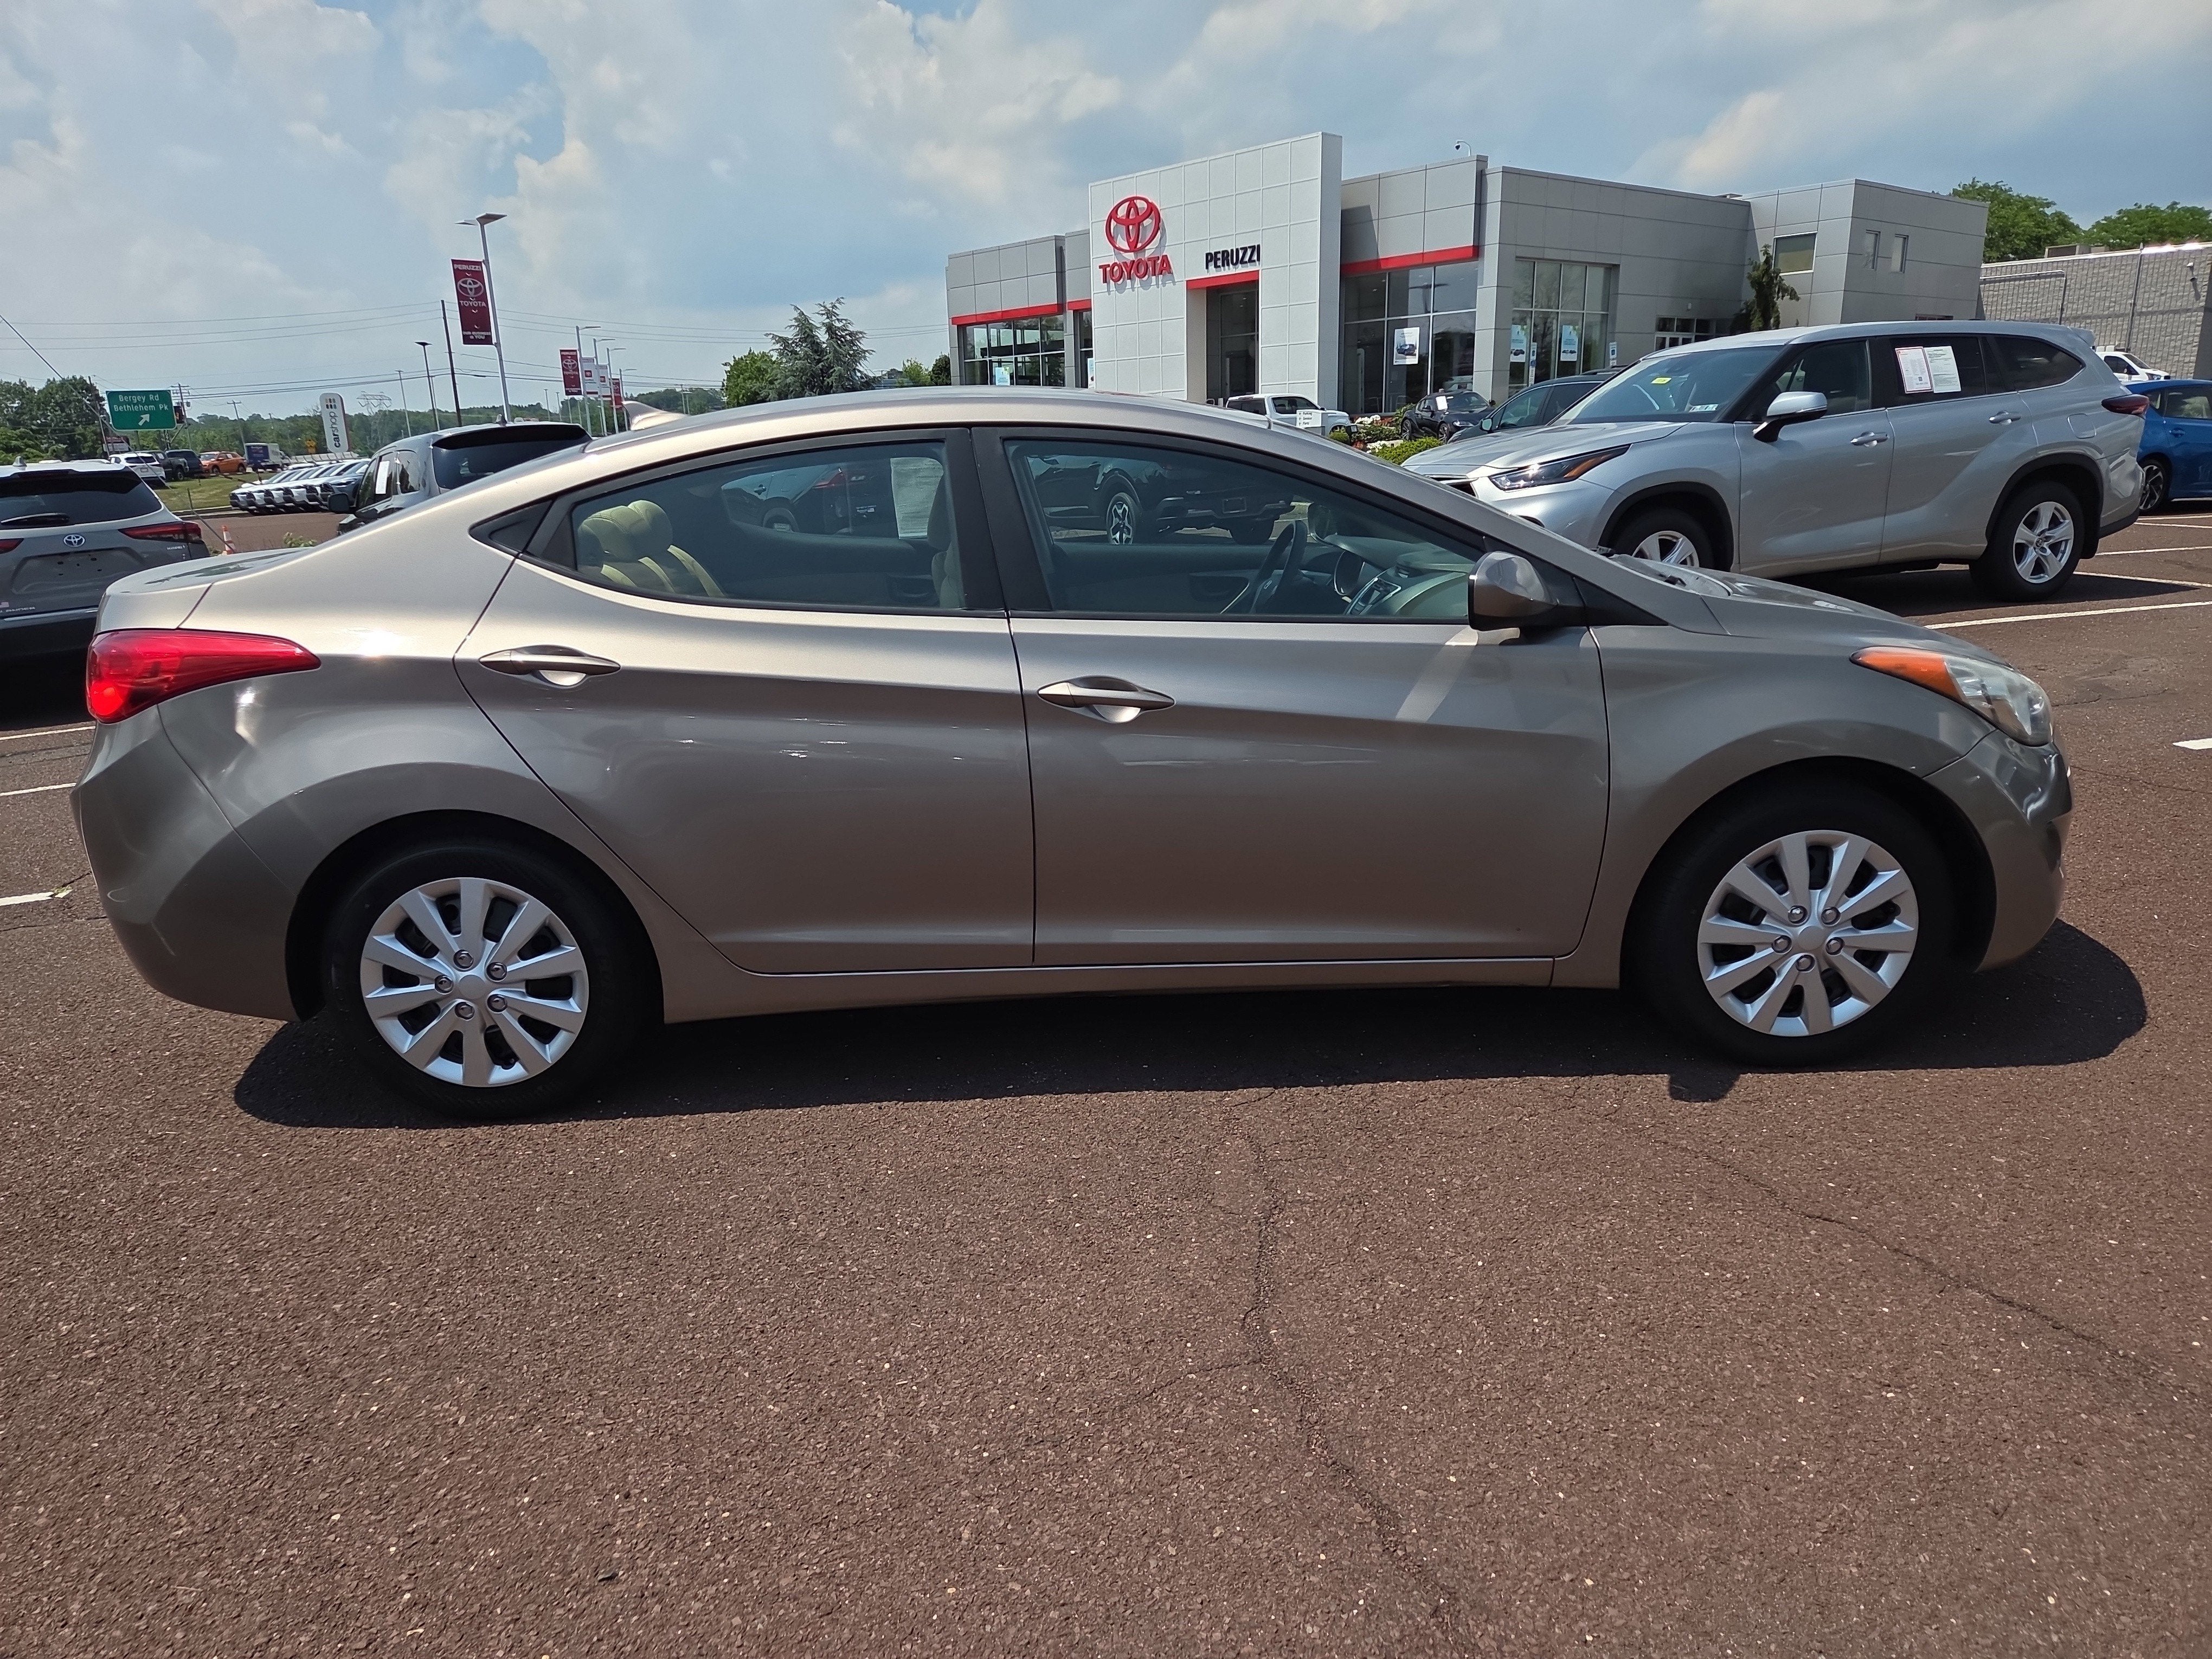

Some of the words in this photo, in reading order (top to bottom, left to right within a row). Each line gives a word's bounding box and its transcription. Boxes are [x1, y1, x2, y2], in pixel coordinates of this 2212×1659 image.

[1098, 254, 1172, 284] TOYOTA
[1205, 244, 1261, 270] PERUZZI
[119, 395, 146, 403] Bergey
[329, 411, 341, 448] carshop
